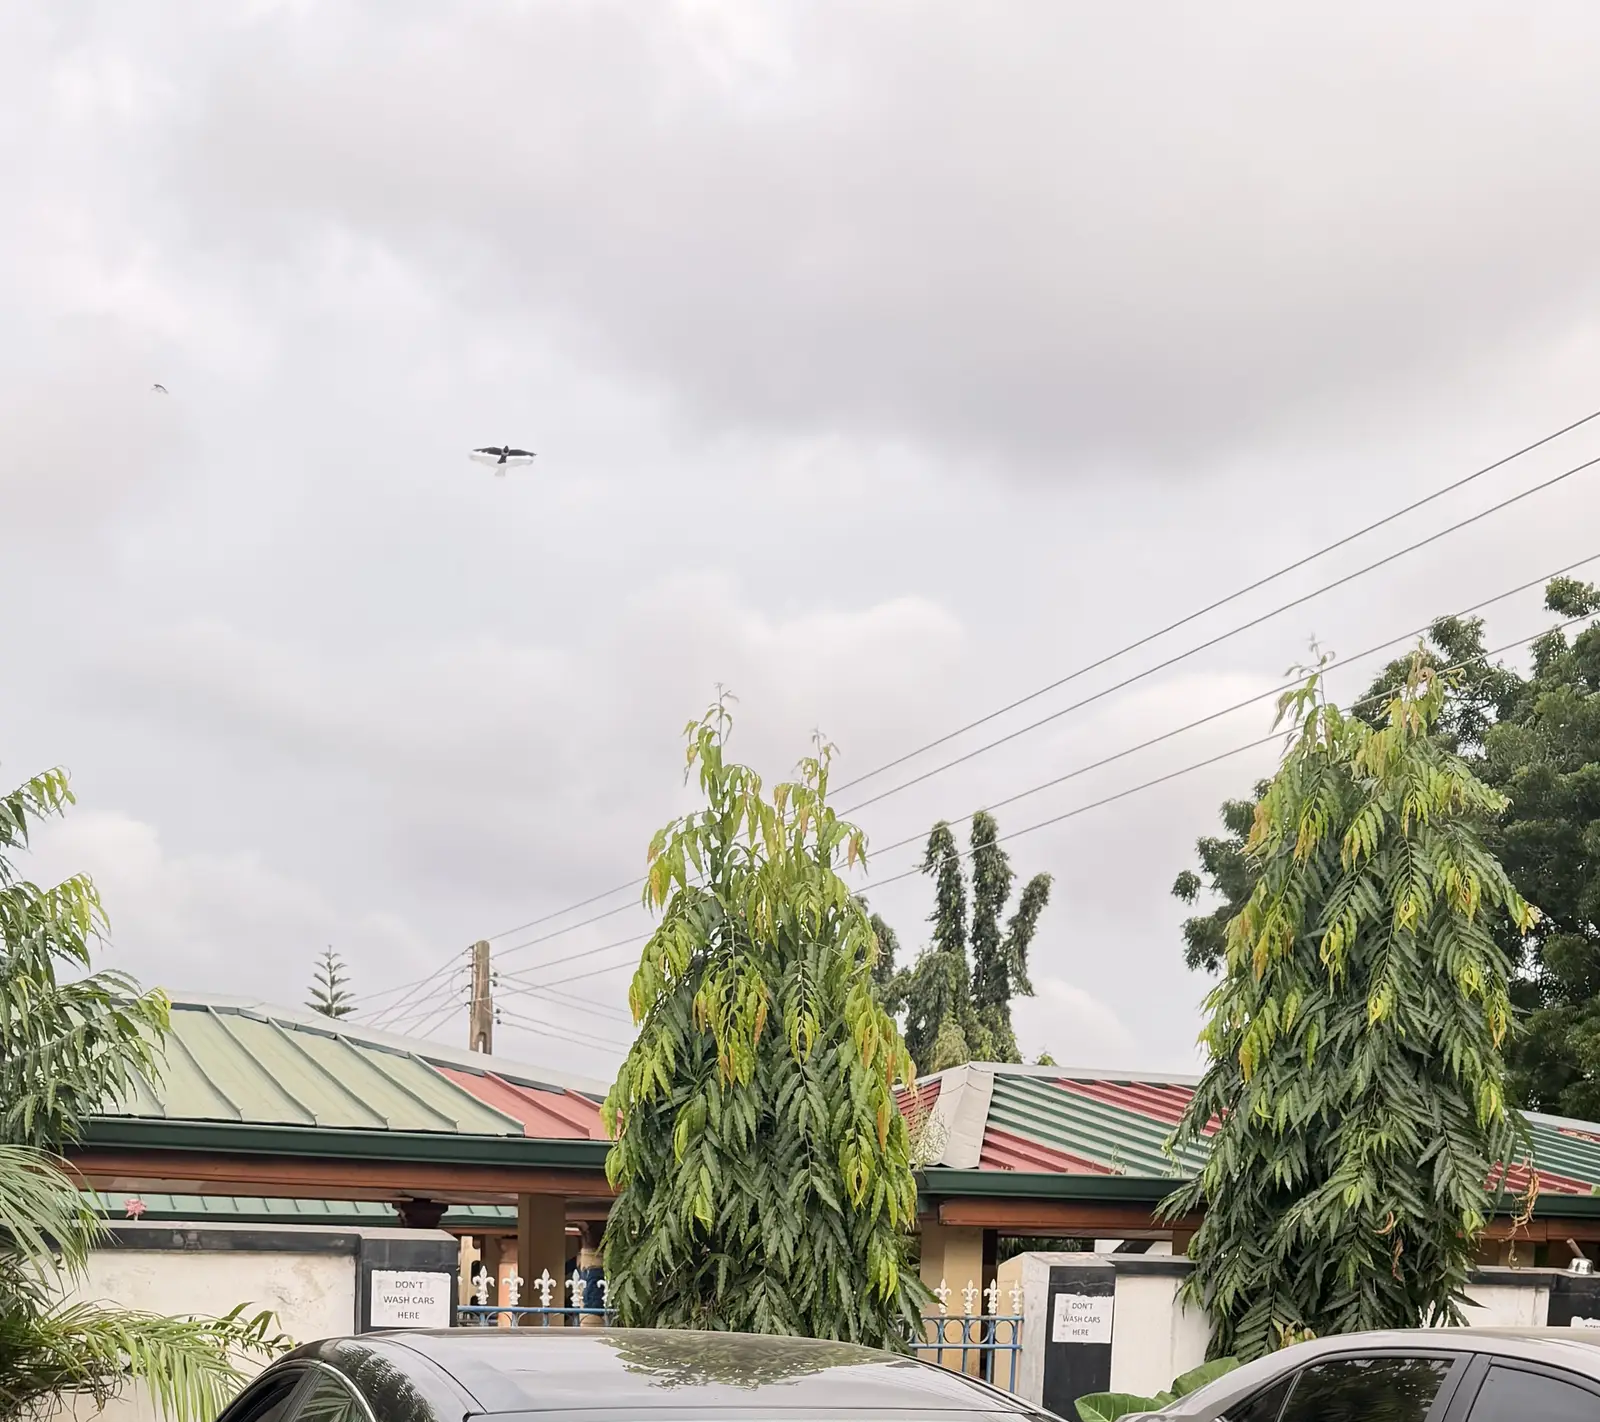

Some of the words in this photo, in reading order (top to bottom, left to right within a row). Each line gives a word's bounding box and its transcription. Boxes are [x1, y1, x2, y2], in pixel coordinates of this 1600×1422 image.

[395, 1280, 424, 1290] DON'T
[383, 1295, 410, 1305] WASH
[412, 1296, 435, 1305] CARS
[1071, 1302, 1093, 1310] DON'T
[397, 1311, 420, 1320] HERE
[1062, 1315, 1083, 1323] WASH
